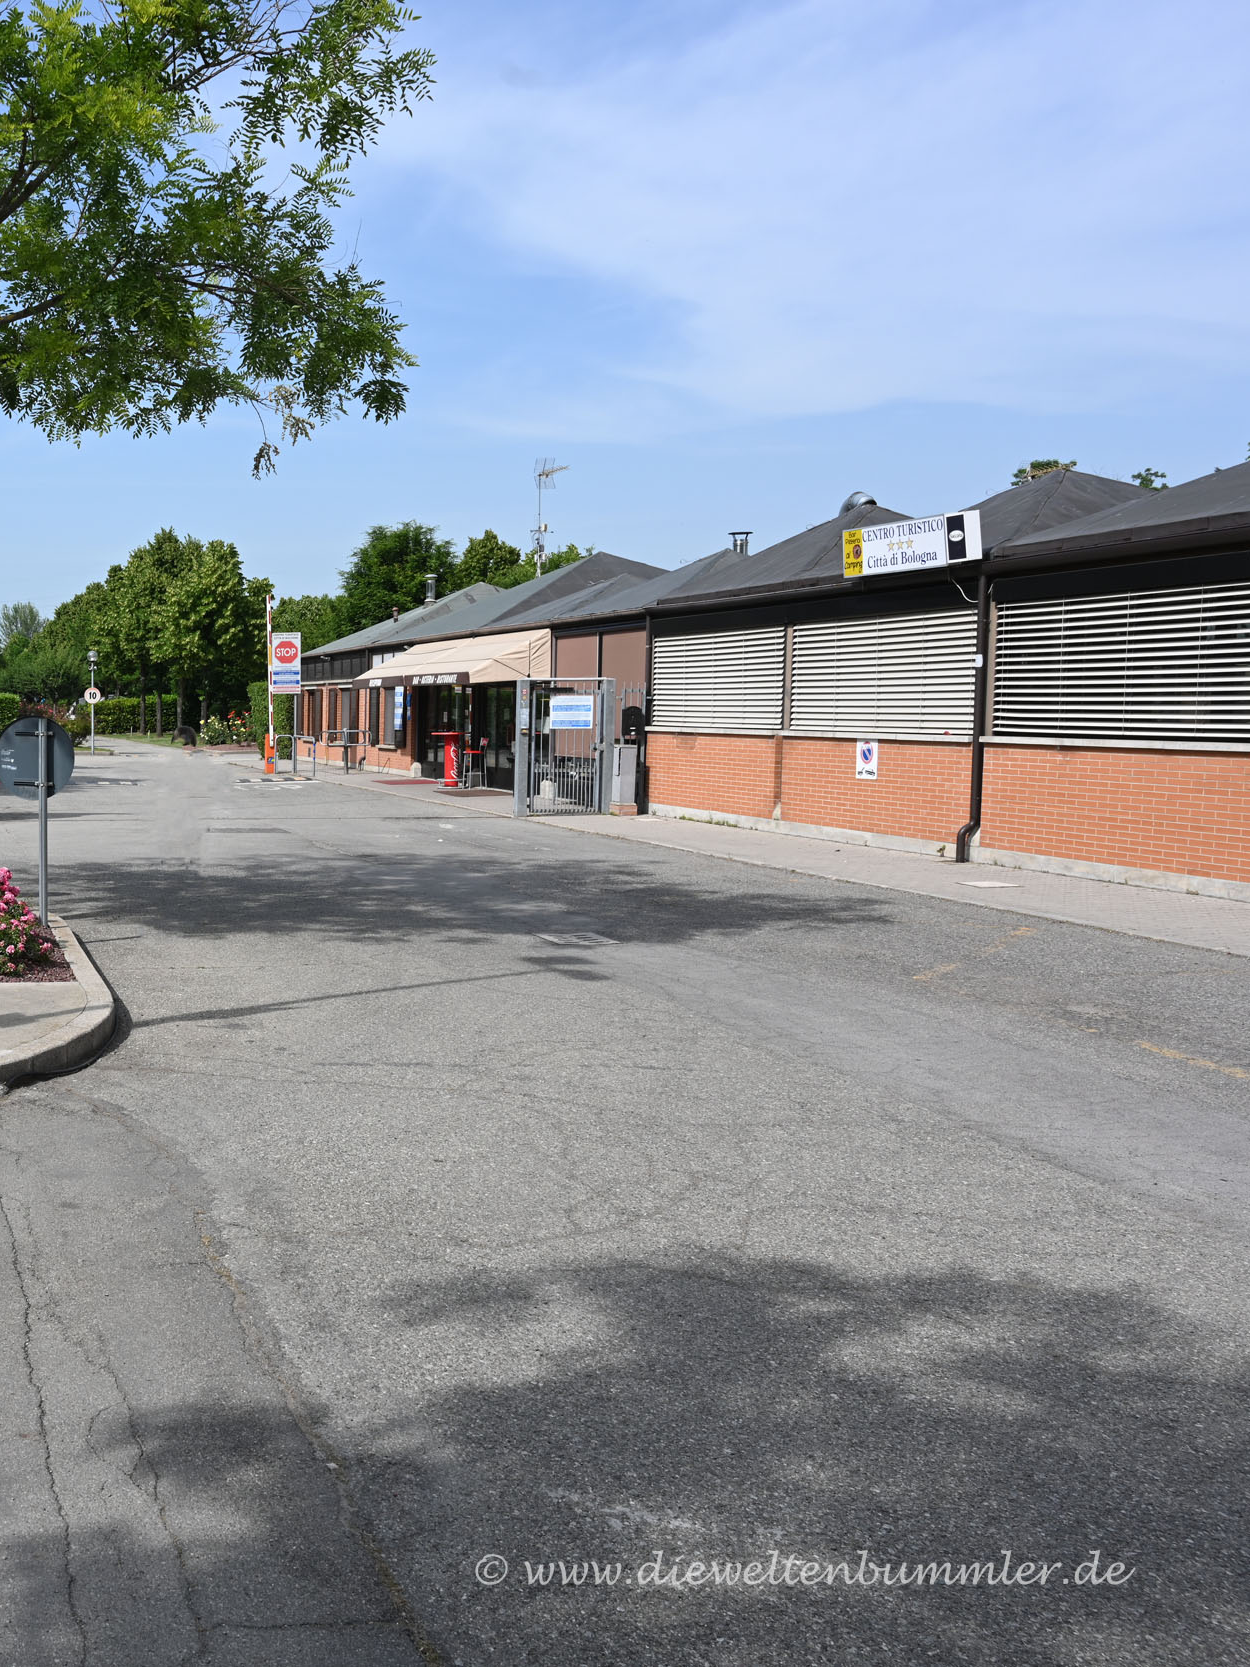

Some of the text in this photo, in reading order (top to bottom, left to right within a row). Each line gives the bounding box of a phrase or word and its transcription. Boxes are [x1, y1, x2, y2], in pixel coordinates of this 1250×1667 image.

[862, 519, 942, 543] CENTRO TURISTICO
[867, 551, 937, 569] Città di Bologna
[276, 647, 297, 657] STOP
[88, 691, 97, 700] 10
